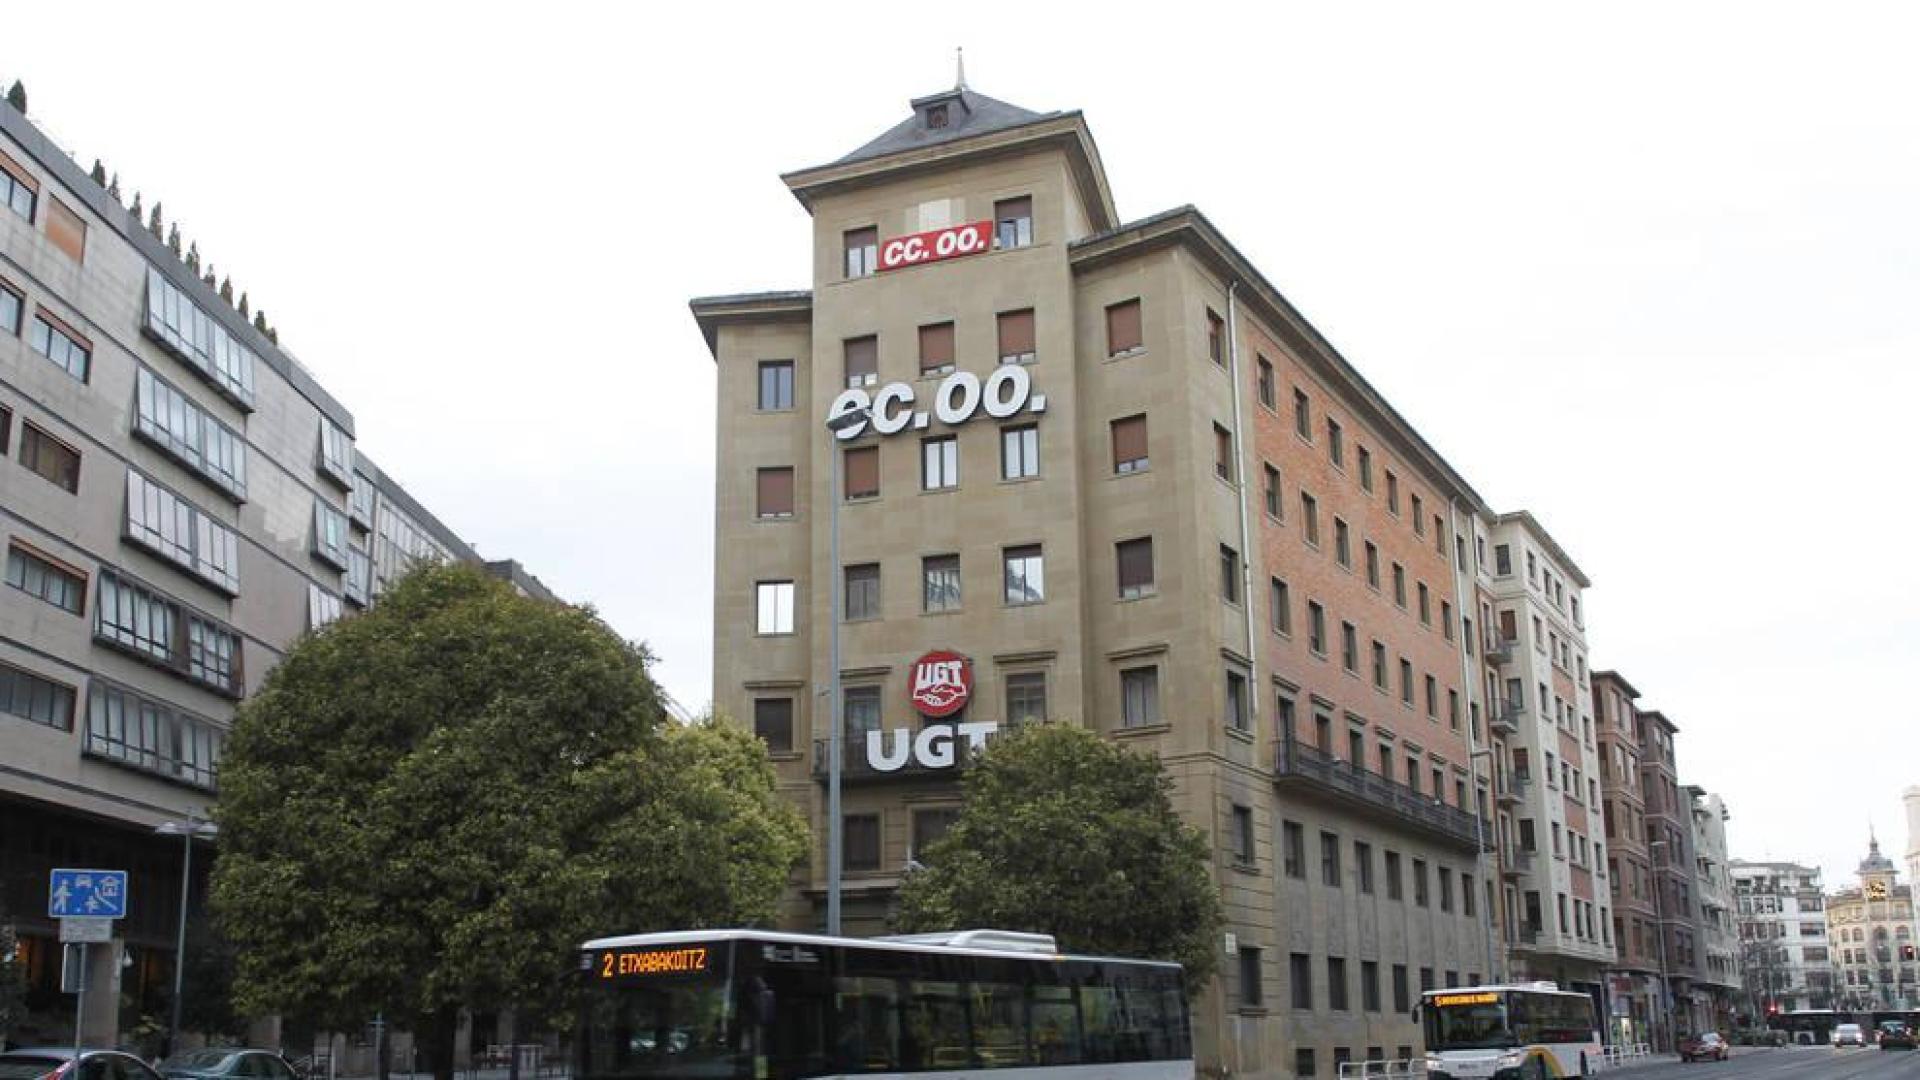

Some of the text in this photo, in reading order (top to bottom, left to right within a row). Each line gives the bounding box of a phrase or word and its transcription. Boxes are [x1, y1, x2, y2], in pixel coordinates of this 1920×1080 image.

[915, 661, 962, 688] UGT
[867, 721, 998, 771] UGT
[603, 953, 614, 977] 2
